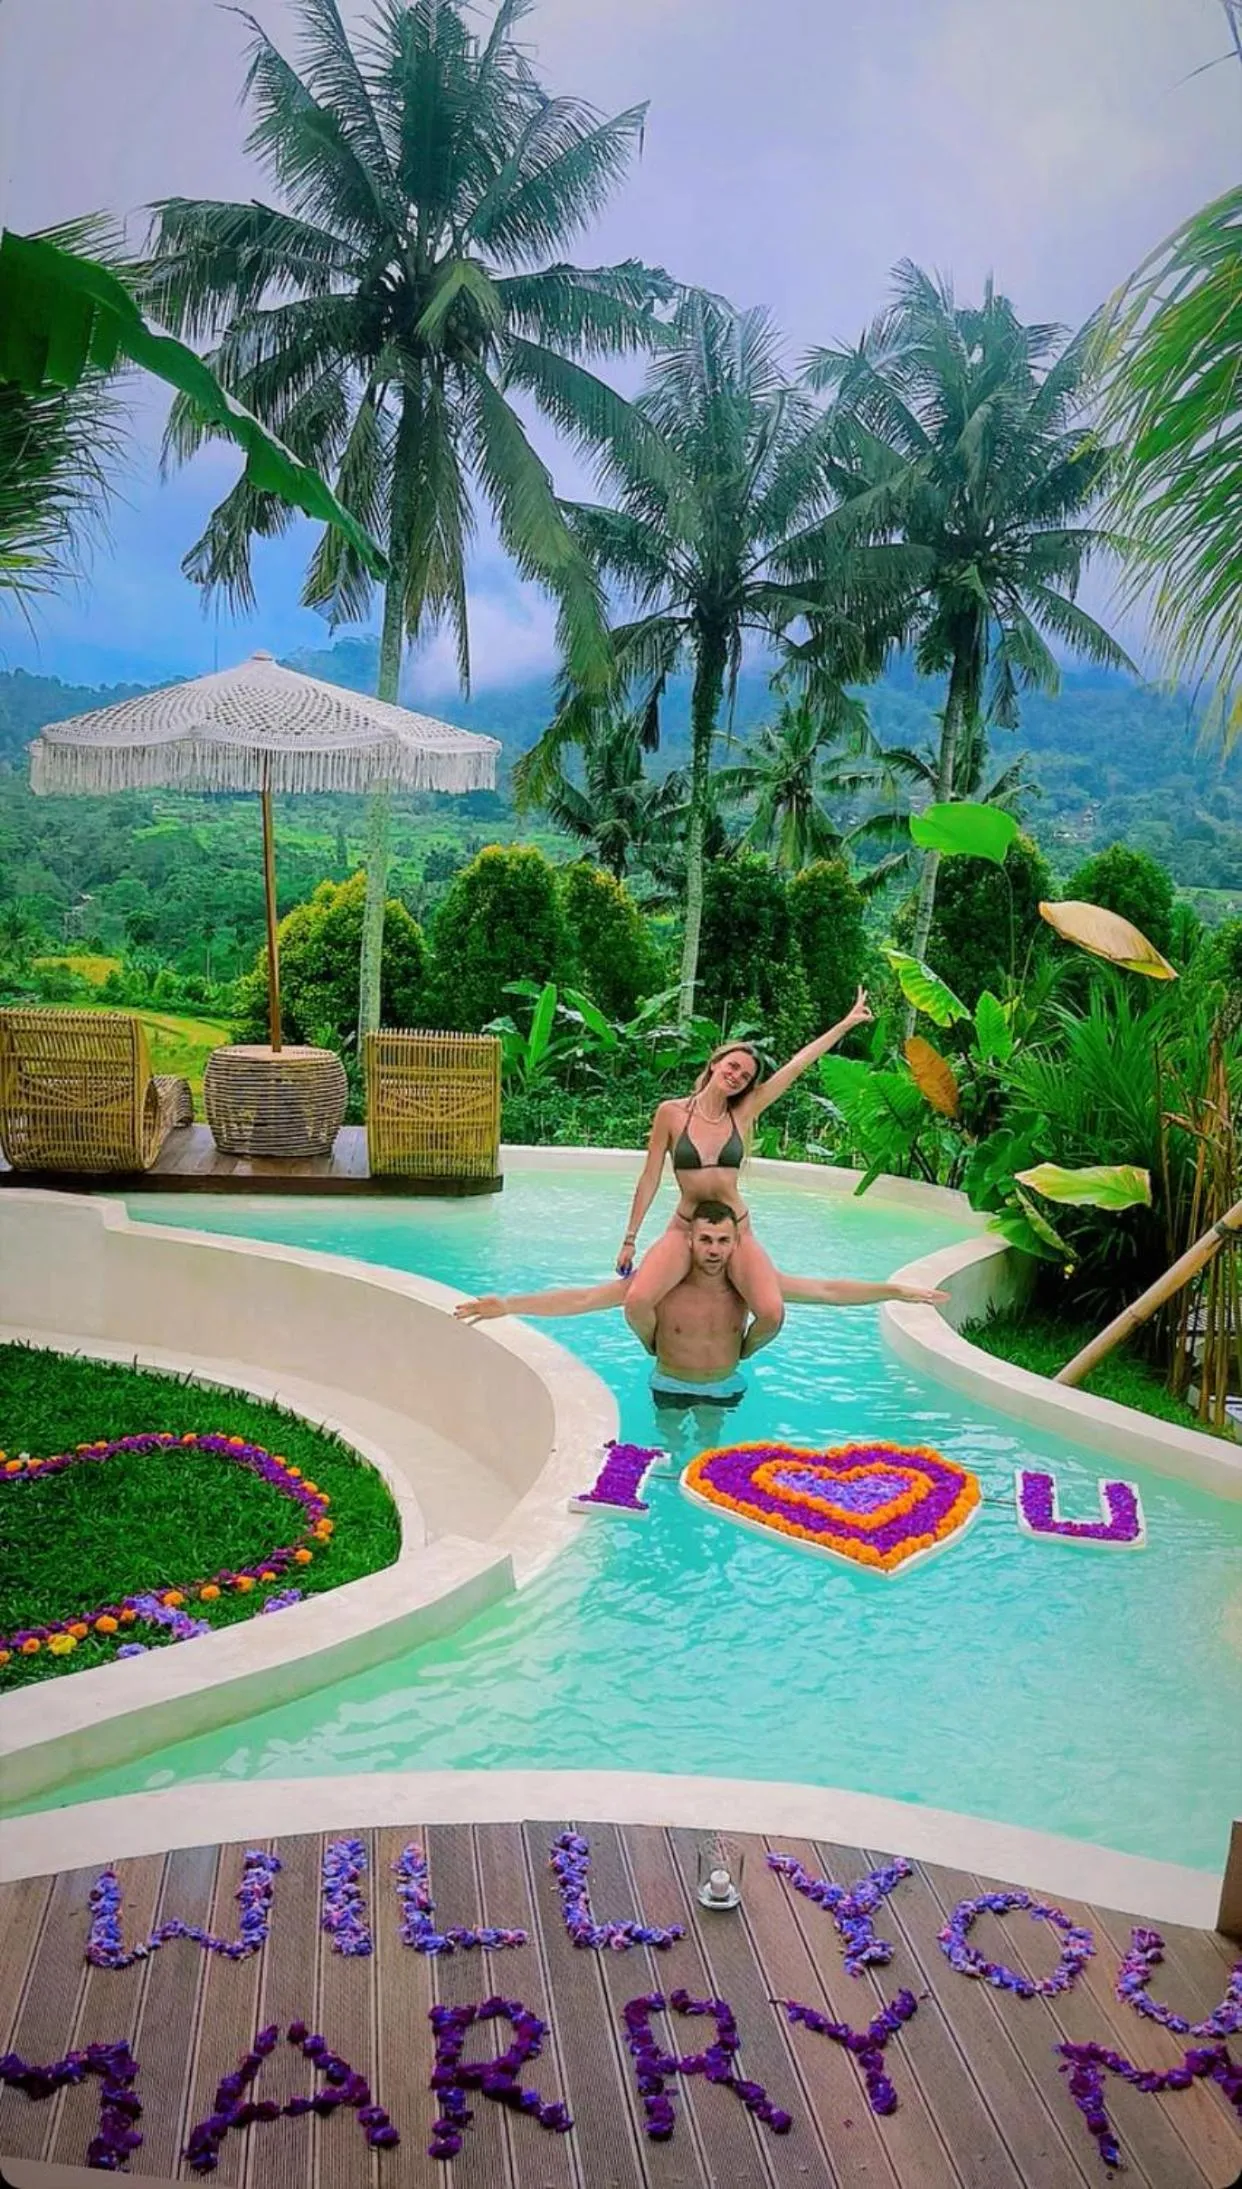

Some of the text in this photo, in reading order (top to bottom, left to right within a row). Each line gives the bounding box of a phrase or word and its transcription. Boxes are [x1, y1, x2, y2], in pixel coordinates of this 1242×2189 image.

[579, 1440, 1139, 1543] I U
[86, 1829, 1242, 2038] WILL YOU
